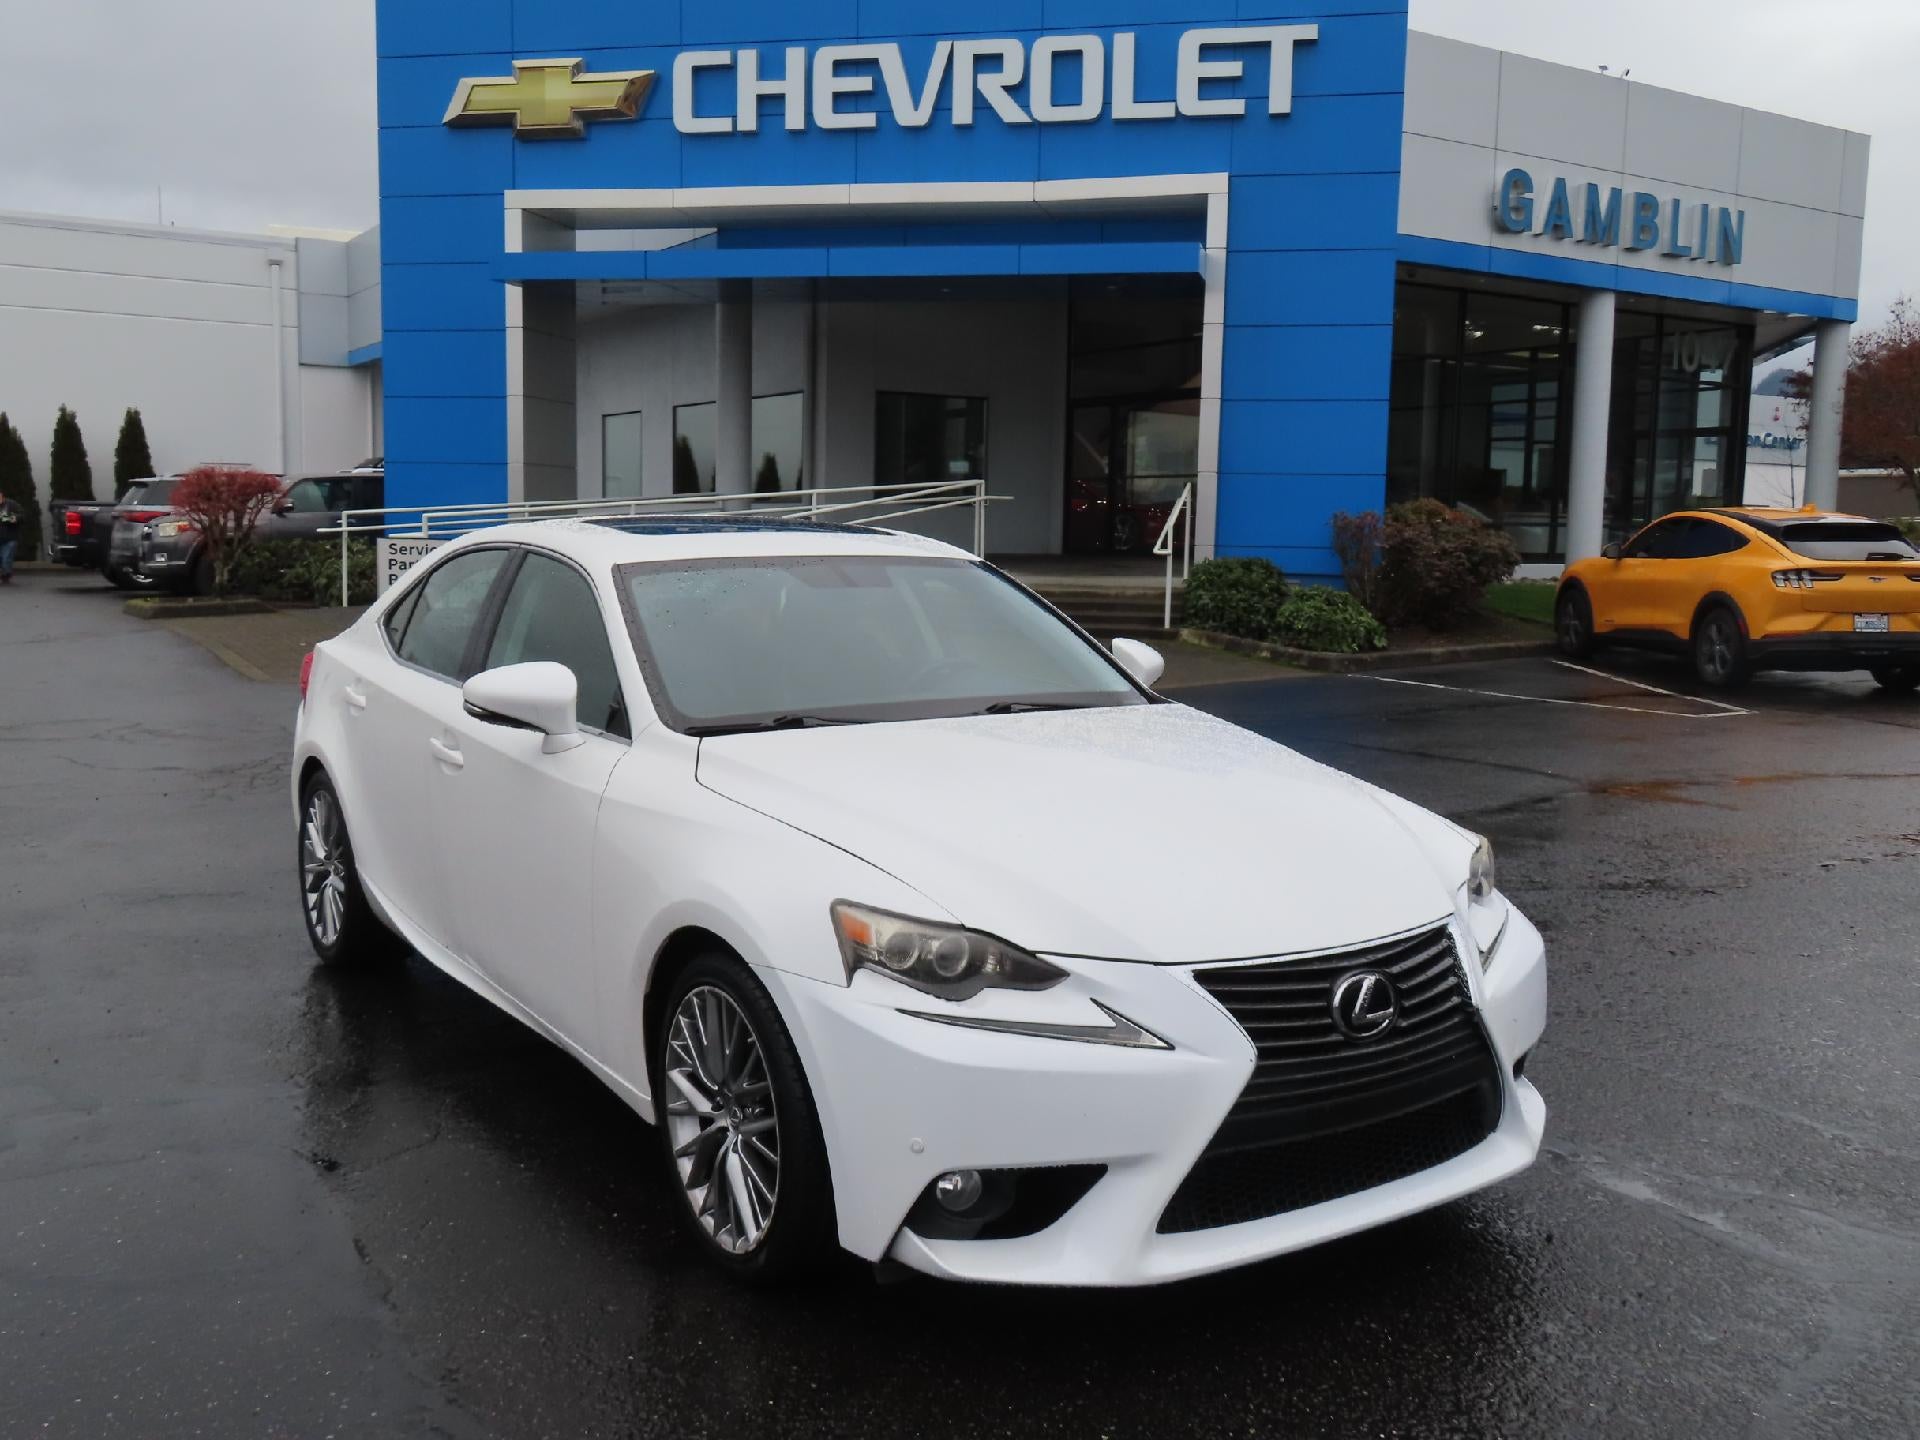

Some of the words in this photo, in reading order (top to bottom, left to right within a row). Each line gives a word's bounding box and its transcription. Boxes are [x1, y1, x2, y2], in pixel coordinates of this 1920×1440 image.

[673, 24, 1319, 134] CHEVROLET
[1500, 168, 1745, 265] GAMBLIN
[388, 559, 419, 570] Par
